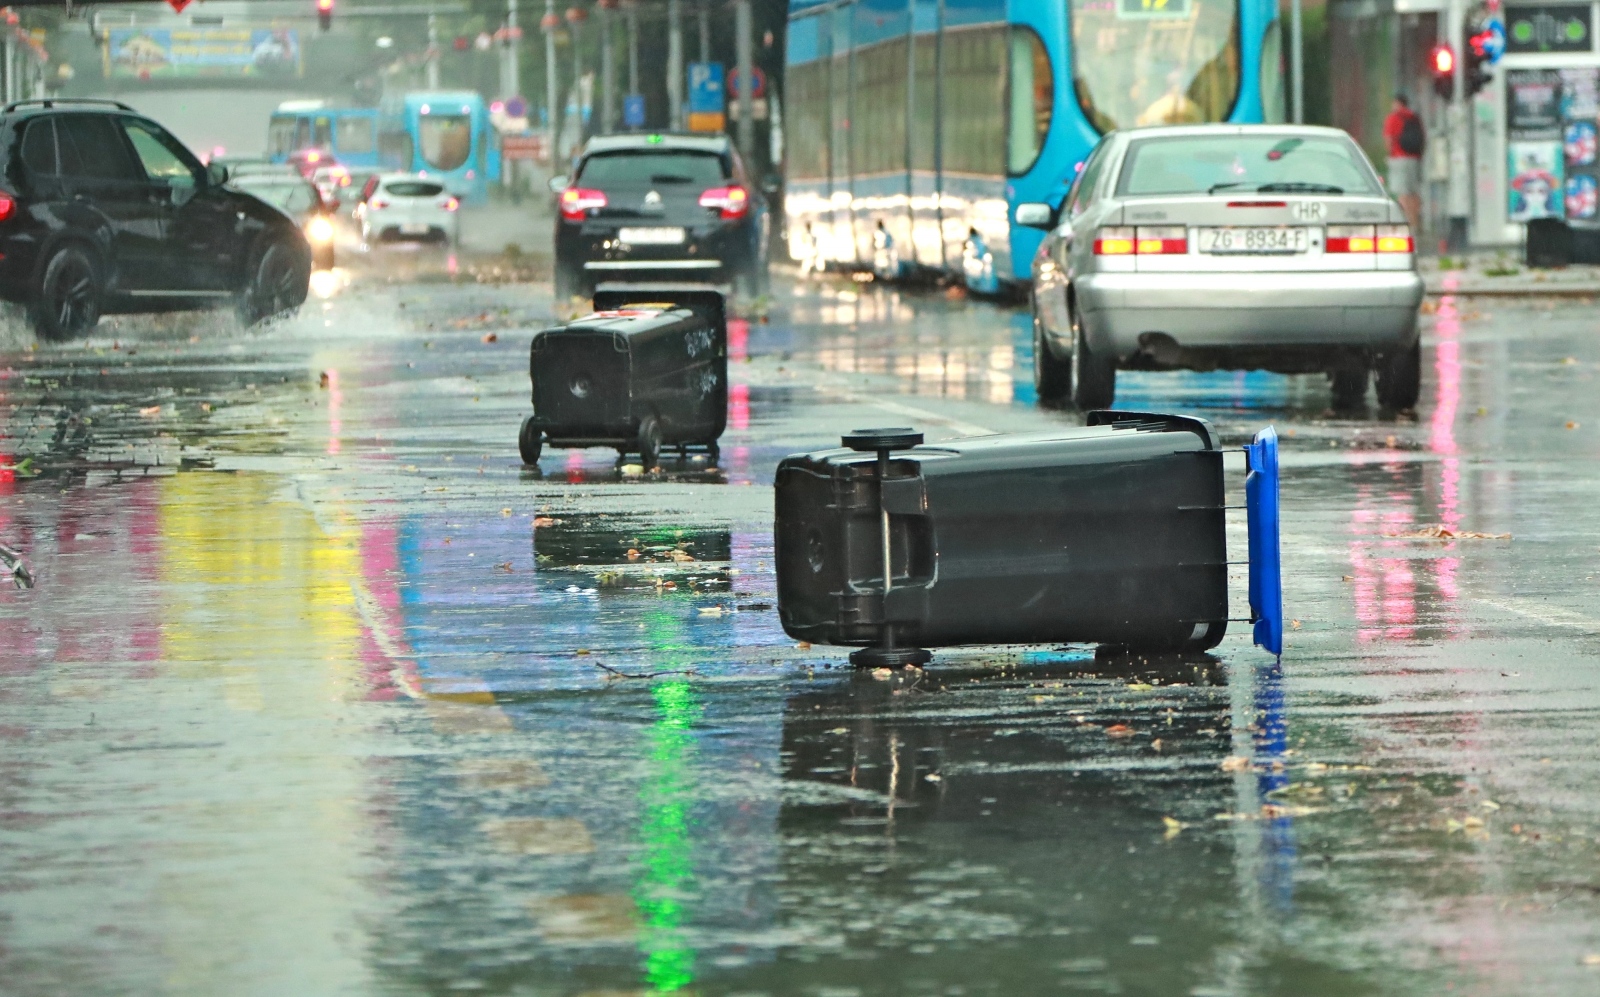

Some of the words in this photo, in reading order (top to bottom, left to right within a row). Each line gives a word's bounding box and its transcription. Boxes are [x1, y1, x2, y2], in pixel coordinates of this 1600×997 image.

[1299, 201, 1321, 219] HR
[1212, 229, 1232, 248] ZG
[1245, 229, 1302, 248] 8934-F
